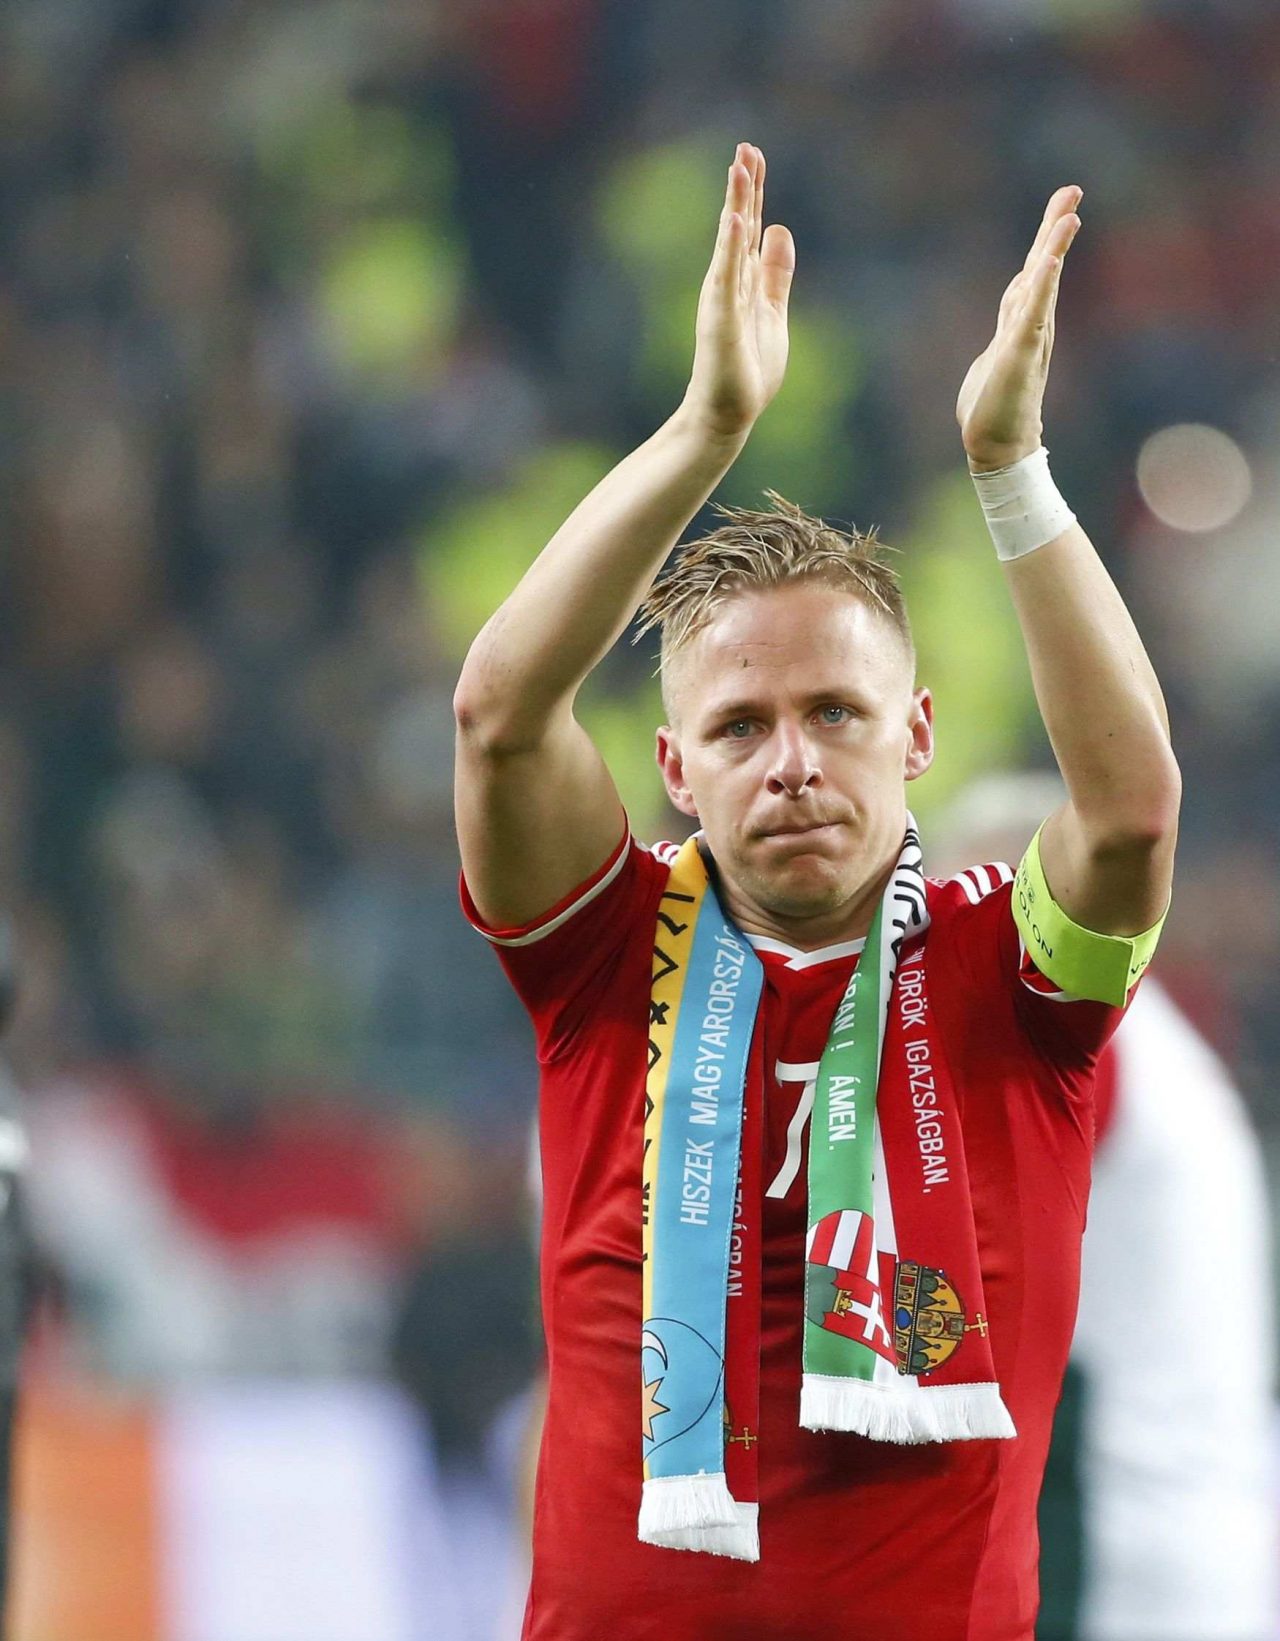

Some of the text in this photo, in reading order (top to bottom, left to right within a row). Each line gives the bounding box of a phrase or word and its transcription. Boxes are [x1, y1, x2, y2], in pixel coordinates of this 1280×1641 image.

[897, 968, 928, 1031] ÖRÖK
[764, 1058, 821, 1200] 7
[679, 1138, 715, 1226] HISZEK
